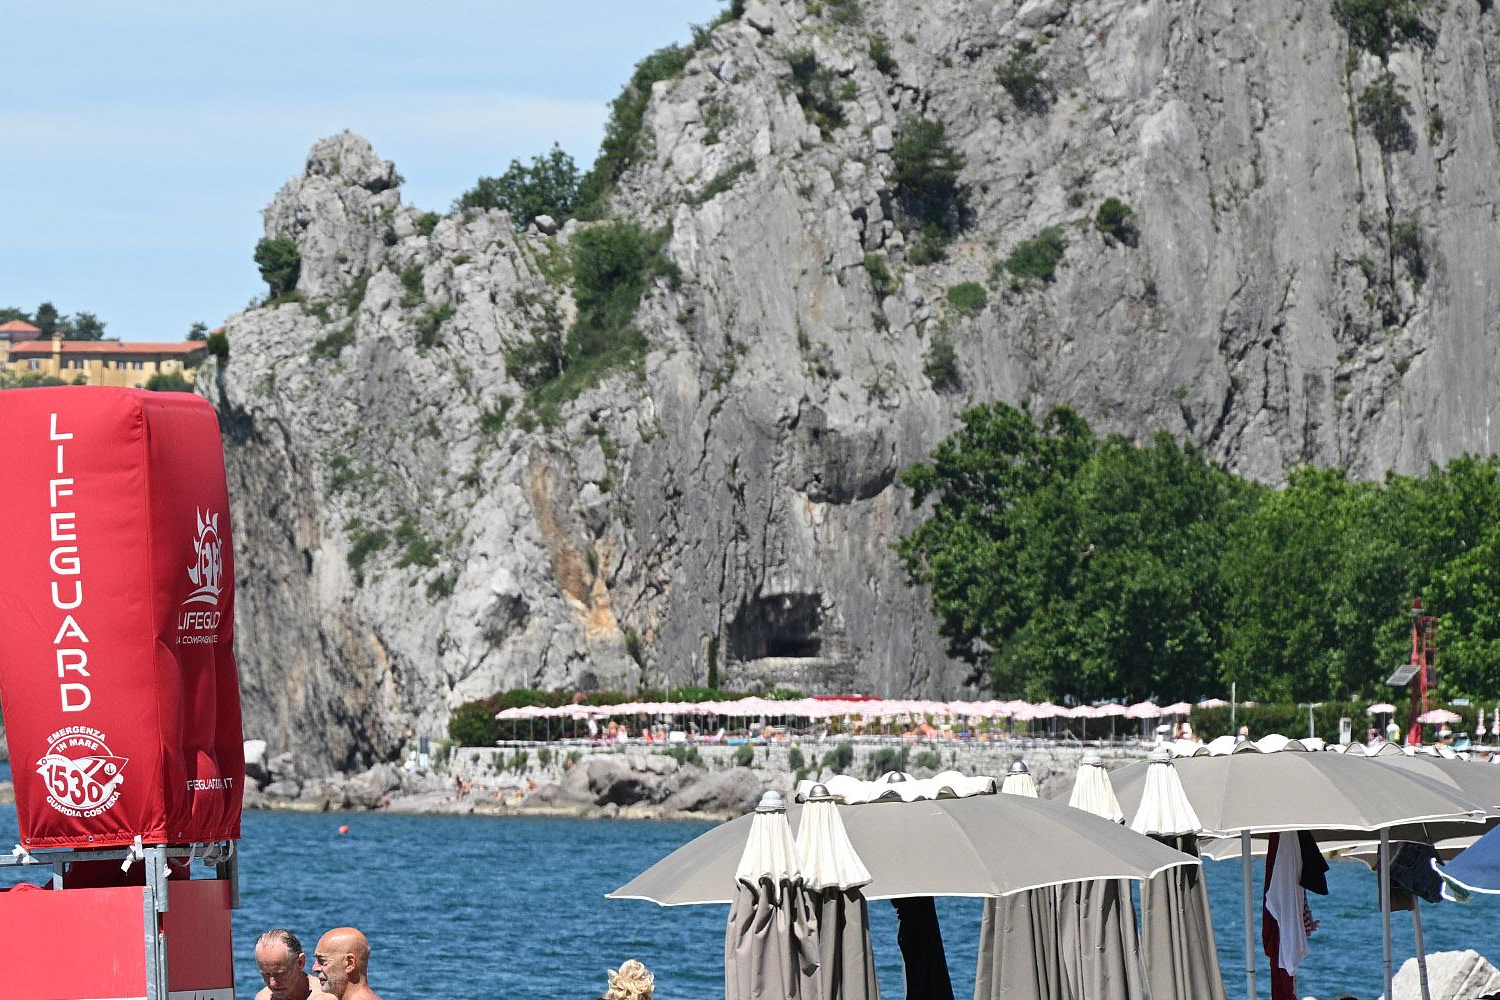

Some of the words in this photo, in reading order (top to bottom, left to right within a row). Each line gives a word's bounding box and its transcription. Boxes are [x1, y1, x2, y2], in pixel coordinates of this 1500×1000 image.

[50, 413, 91, 712] LIFEGUARD
[47, 726, 106, 744] EMERGENZA
[56, 742, 67, 753] IN
[69, 739, 98, 751] MARE
[47, 764, 103, 806] 1530
[46, 795, 82, 818] GUARDIA
[84, 791, 121, 818] COSTIERA
